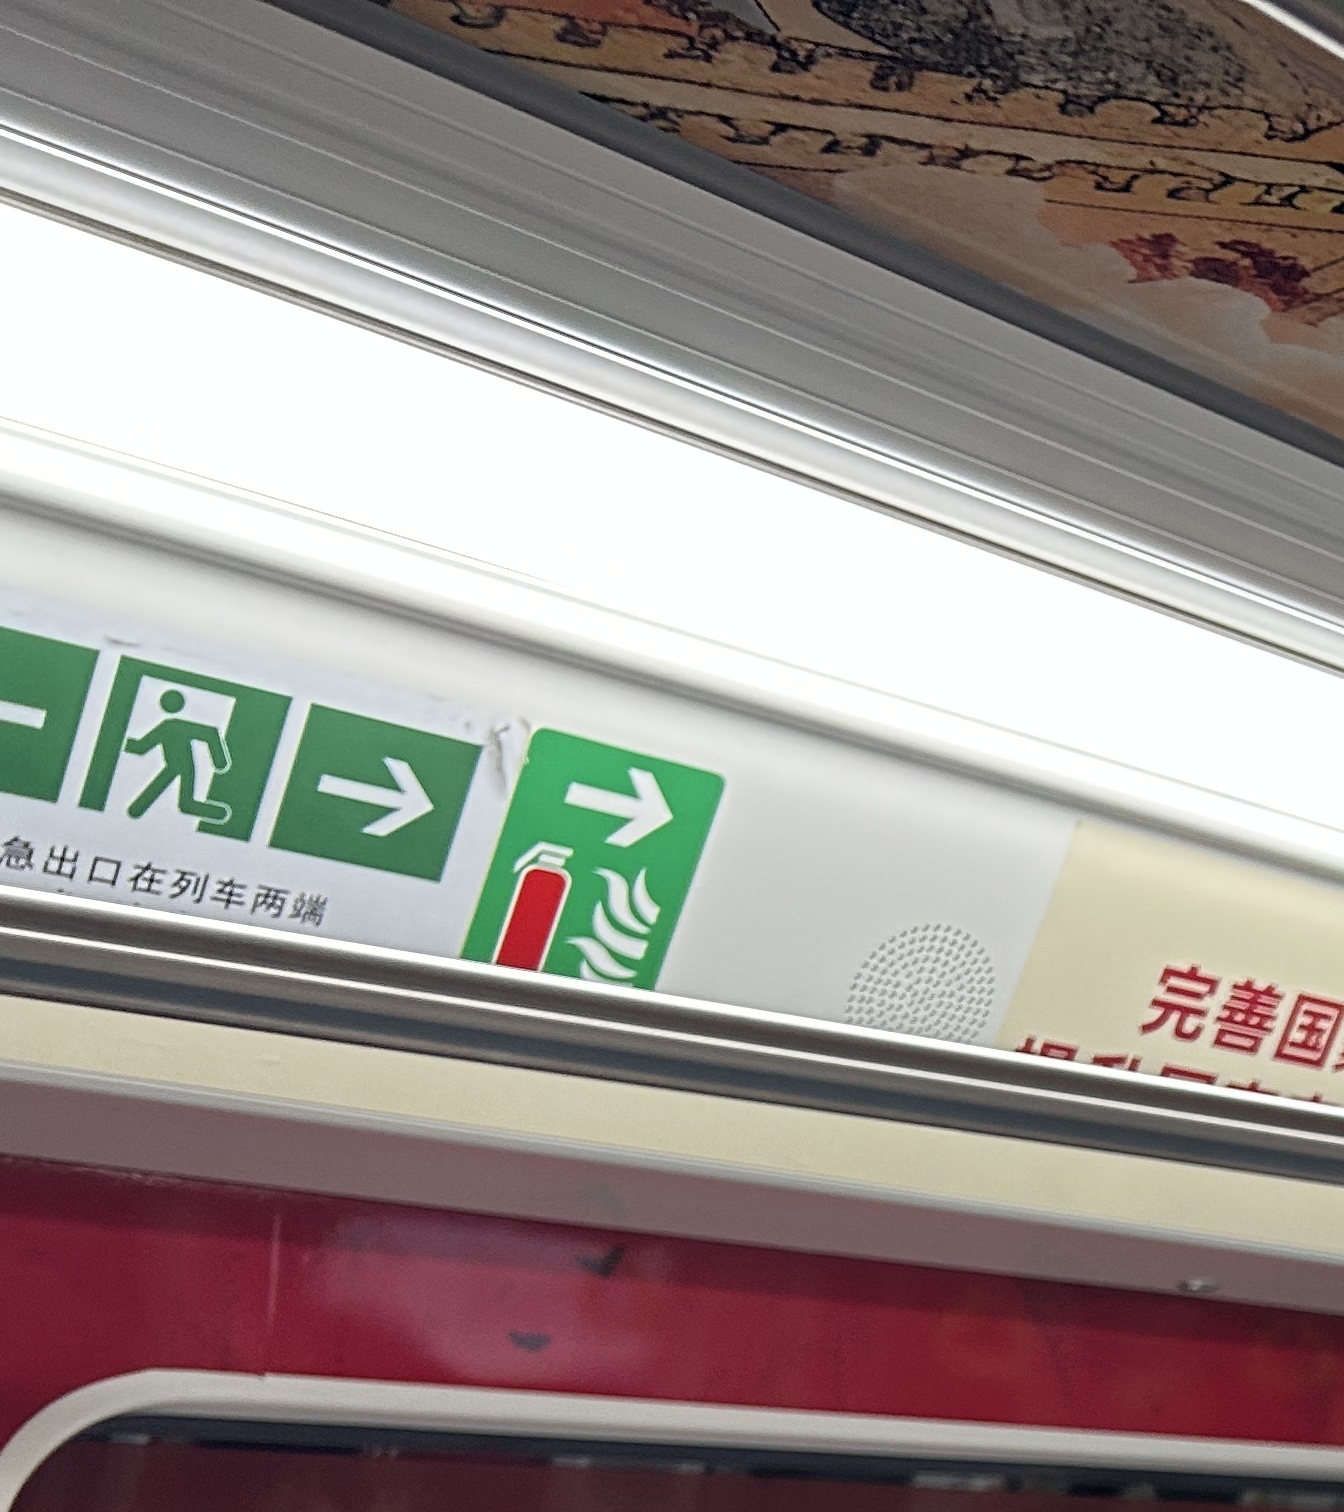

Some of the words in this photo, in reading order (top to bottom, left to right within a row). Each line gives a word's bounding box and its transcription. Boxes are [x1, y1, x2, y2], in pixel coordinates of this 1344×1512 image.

[0, 834, 329, 928] 急出口在列车两端
